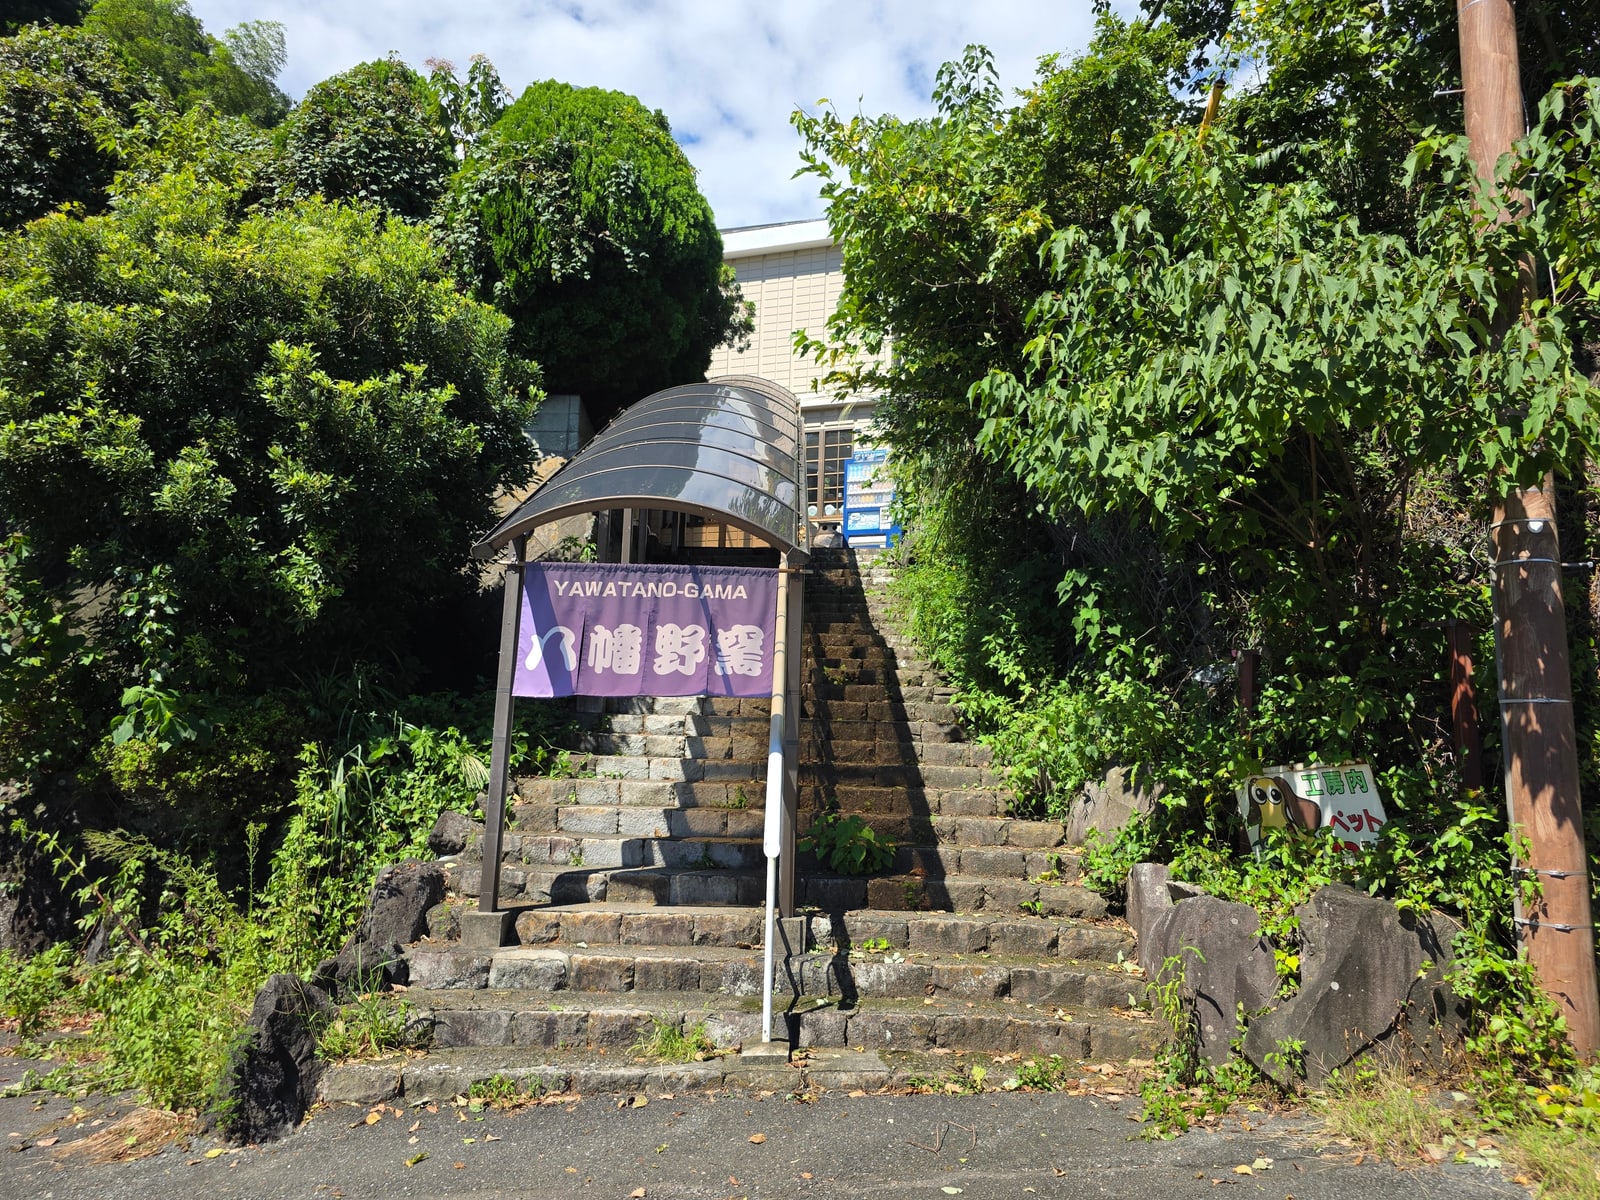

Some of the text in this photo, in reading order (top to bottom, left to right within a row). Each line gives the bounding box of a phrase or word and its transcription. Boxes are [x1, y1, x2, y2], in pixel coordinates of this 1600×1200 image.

[554, 580, 748, 599] YAWATANO-GAMA
[1301, 769, 1368, 796] 工房内
[1330, 809, 1383, 832] ペット
